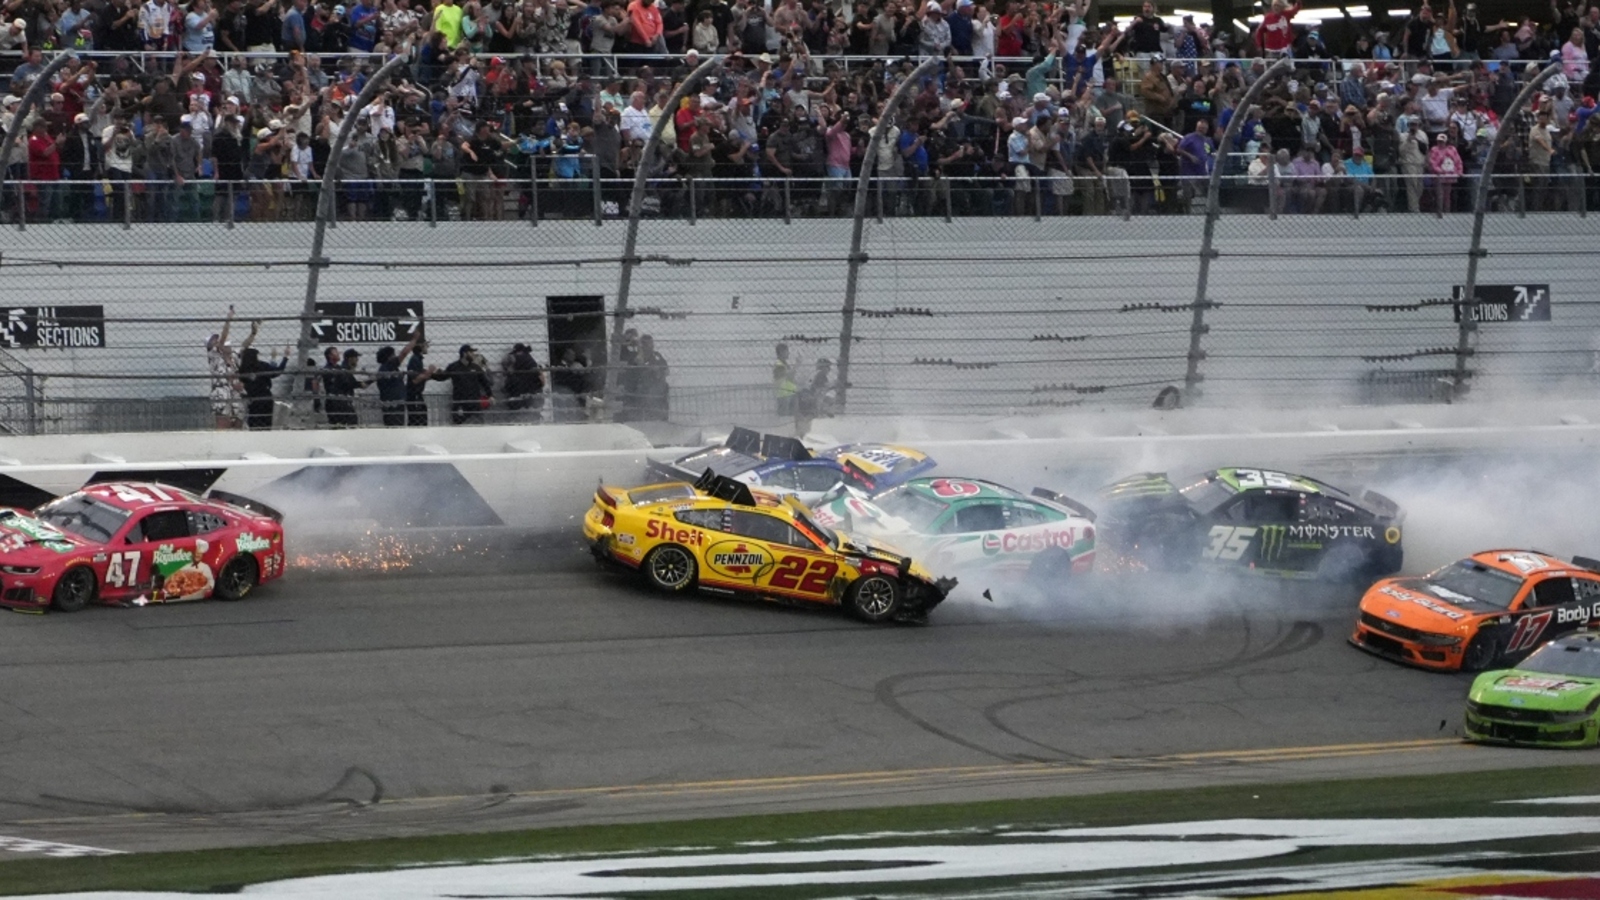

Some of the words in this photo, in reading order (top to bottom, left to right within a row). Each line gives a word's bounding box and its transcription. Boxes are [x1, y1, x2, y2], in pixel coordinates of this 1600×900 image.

[37, 307, 60, 326] ALL
[1460, 303, 1508, 320] CTIONS
[37, 327, 100, 346] SECTIONS
[336, 322, 396, 341] SECTIONS
[1236, 469, 1291, 488] 35
[645, 519, 704, 546] Shell
[1002, 527, 1076, 552] Castrol
[1289, 524, 1375, 539] MONSTER
[1202, 525, 1258, 560] 35
[713, 553, 764, 565] PENNZOIL
[105, 550, 141, 588] 47
[768, 555, 839, 594] 22
[1557, 605, 1591, 625] Body
[1505, 611, 1554, 655] 17
